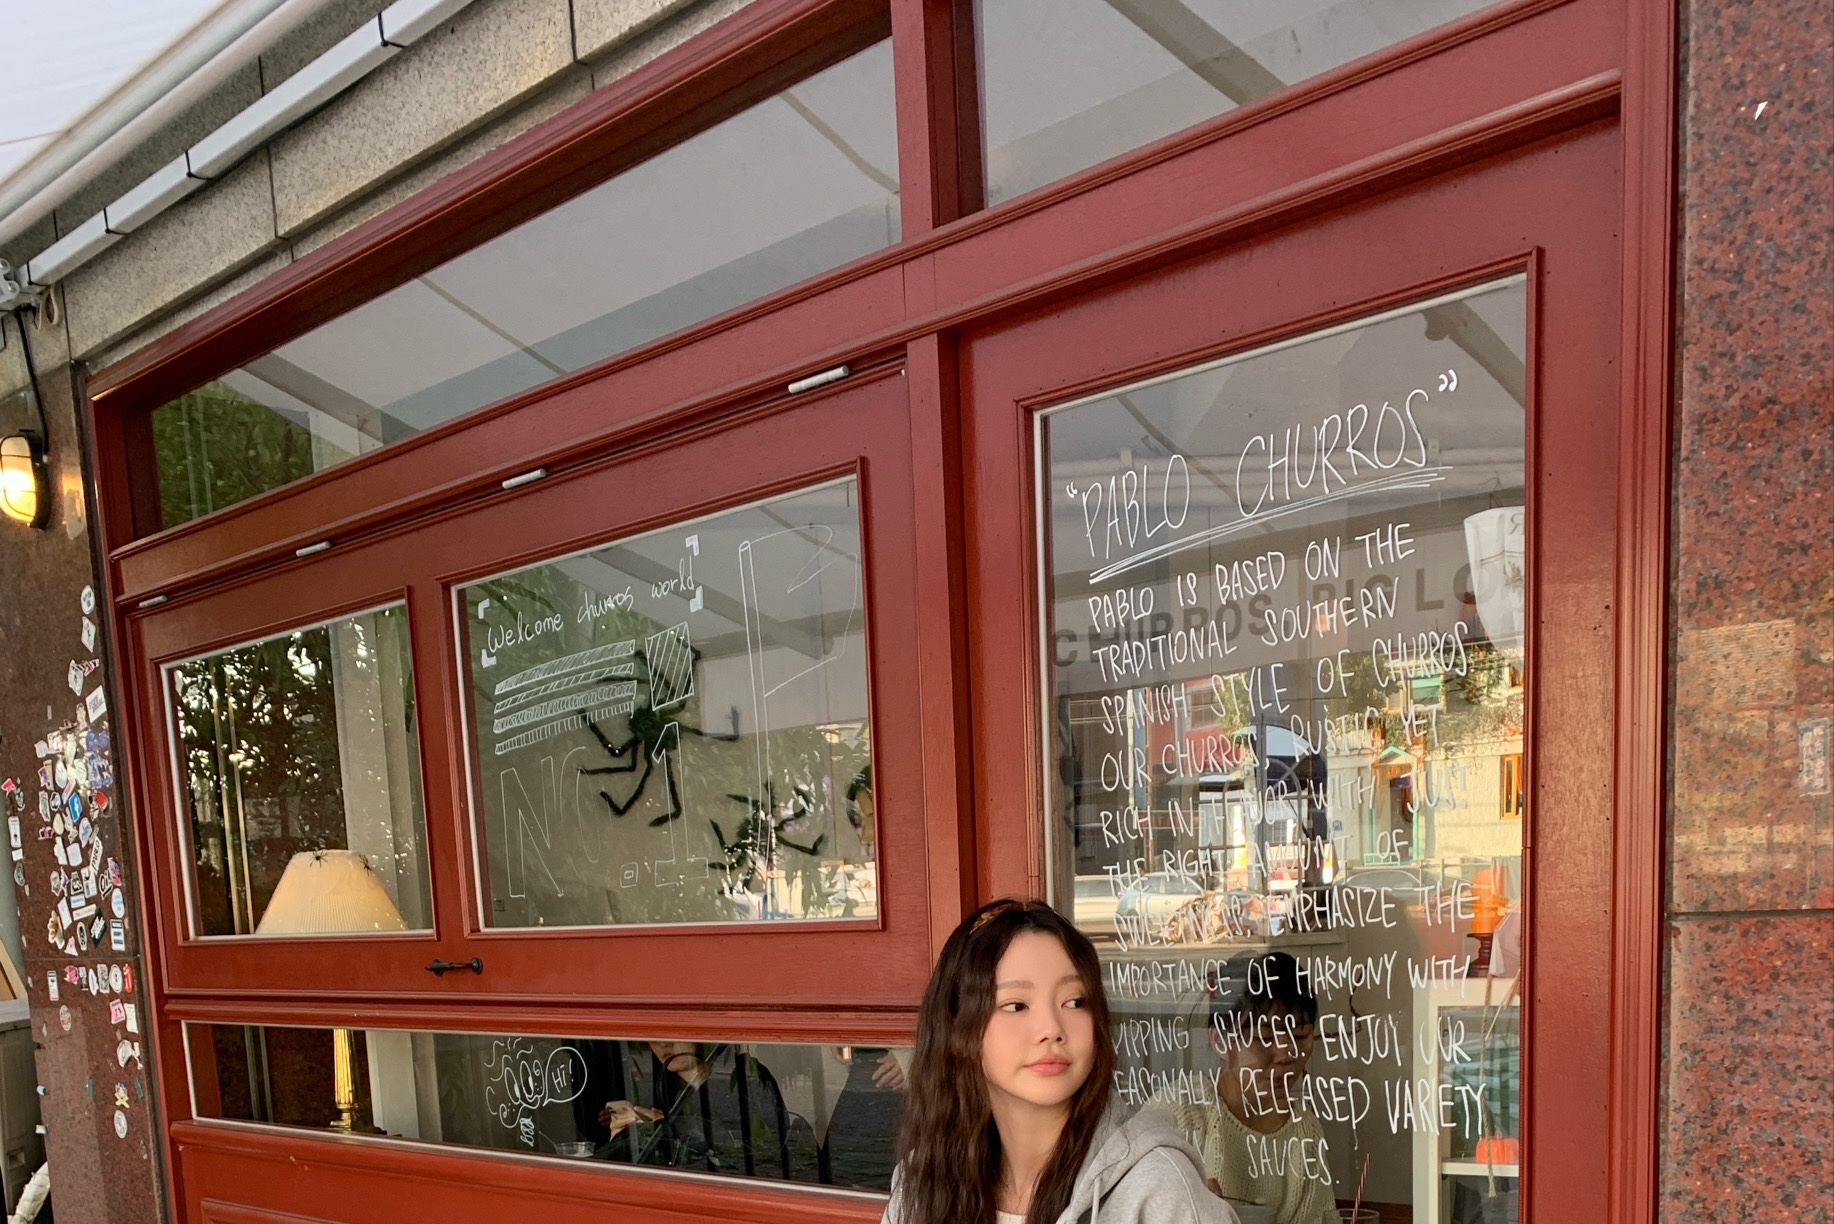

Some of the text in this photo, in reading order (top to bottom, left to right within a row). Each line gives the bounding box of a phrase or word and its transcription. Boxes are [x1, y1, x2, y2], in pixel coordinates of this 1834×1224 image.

[487, 610, 565, 654] Welcome
[651, 555, 695, 599] world
[1088, 523, 1416, 633] PABLO IS BASED ON THE
[1092, 576, 1400, 683] TRADITIONAL SOUTHERN
[1100, 620, 1469, 737] SPANISH STYLE OF CHURROS
[1100, 746, 1152, 792] OUR
[1290, 705, 1380, 763] RUSTIC
[1399, 699, 1441, 748] YET
[1099, 804, 1153, 849] RICH
[1167, 796, 1196, 838] IN
[1308, 774, 1377, 811] WITH
[1102, 828, 1409, 898] THE RIGHT AMOUNT OF
[1267, 884, 1398, 937] EMPHASIZE
[1413, 879, 1480, 934] THE
[1109, 950, 1472, 1001] IMPORTANCE OF HARMONY WITH
[1213, 1009, 1307, 1060] SAUCES.
[1319, 1013, 1403, 1067] ENJOY
[1419, 1015, 1473, 1066] OUR
[1112, 1065, 1488, 1139] EASONALLY RELEASED VARIETY
[1245, 1133, 1341, 1187] SAUCES.
